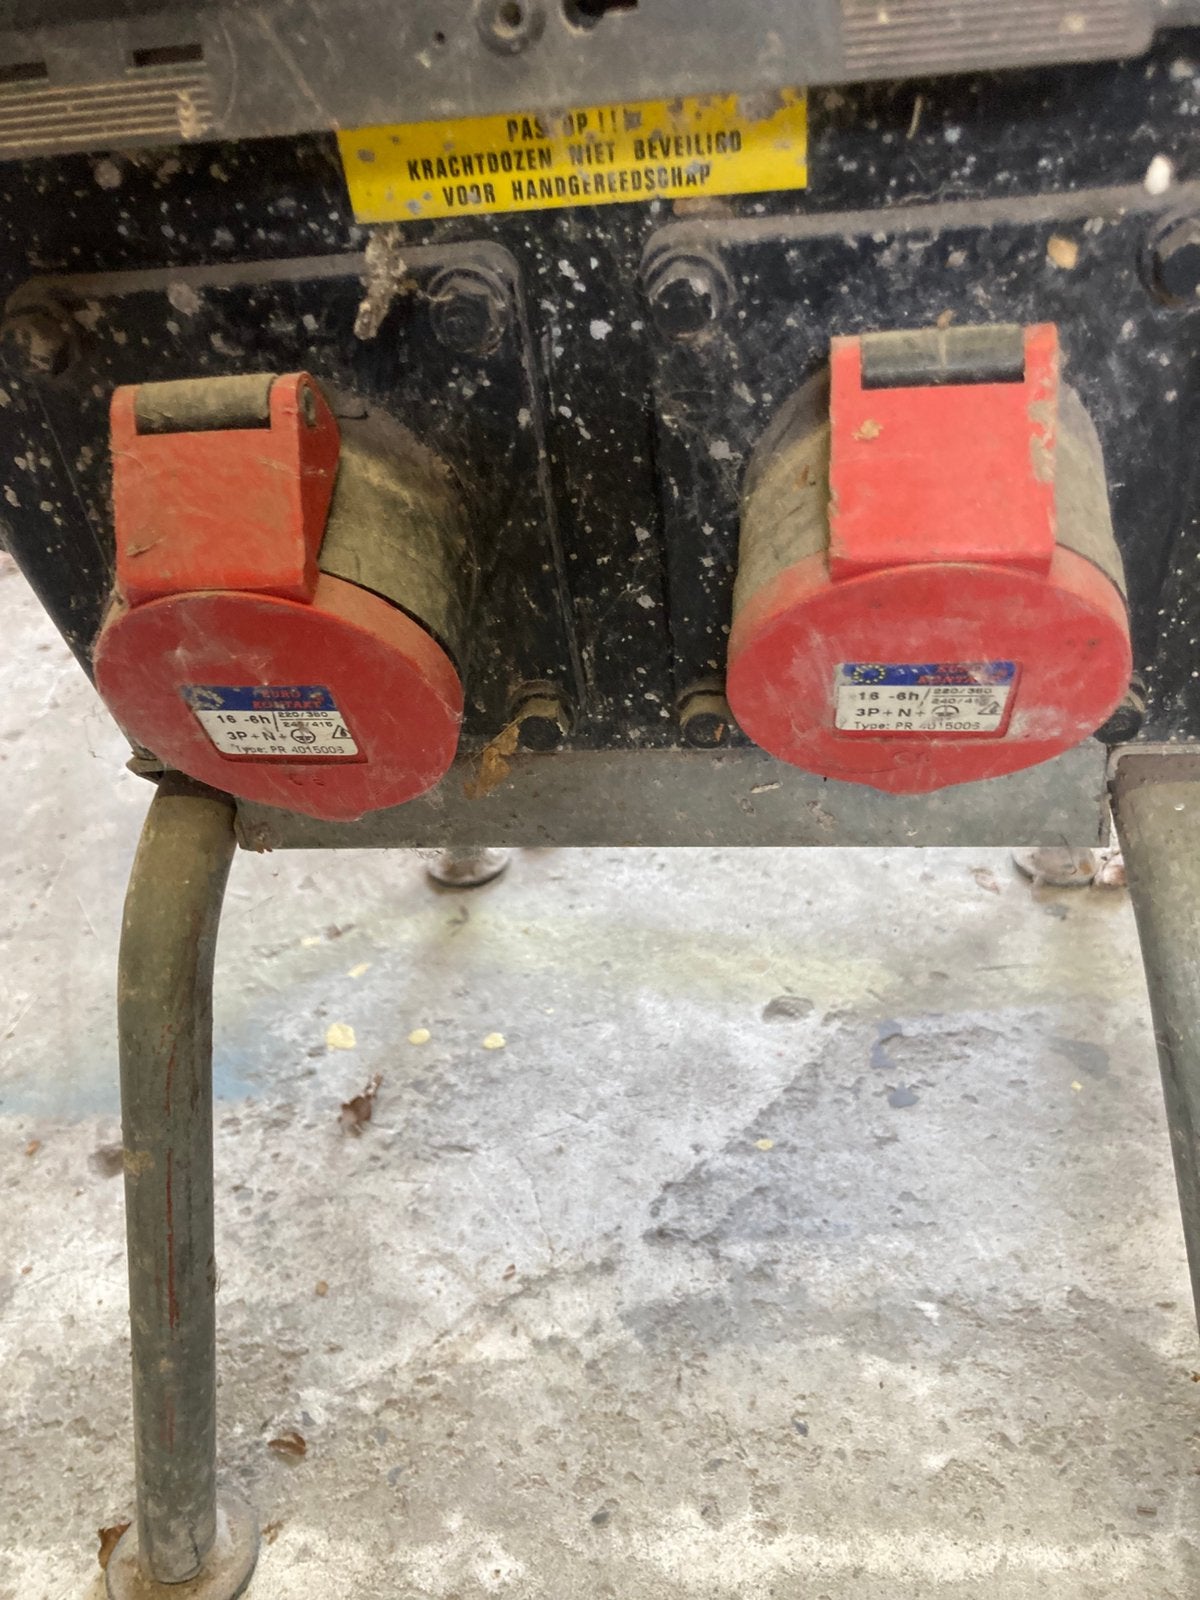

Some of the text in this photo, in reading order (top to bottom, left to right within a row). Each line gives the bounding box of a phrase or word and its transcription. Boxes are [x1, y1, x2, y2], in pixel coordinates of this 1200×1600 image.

[507, 116, 545, 142] PAS
[406, 146, 553, 181] KRACHTDOZEN
[568, 141, 615, 167] NIET
[442, 163, 712, 207] VOOR HANDGEREEDSCHAP
[858, 691, 880, 701] 16
[216, 714, 237, 724] 16
[854, 721, 891, 731] Type:
[895, 720, 913, 730] PR
[231, 744, 268, 755] Type:
[269, 744, 287, 754] PR
